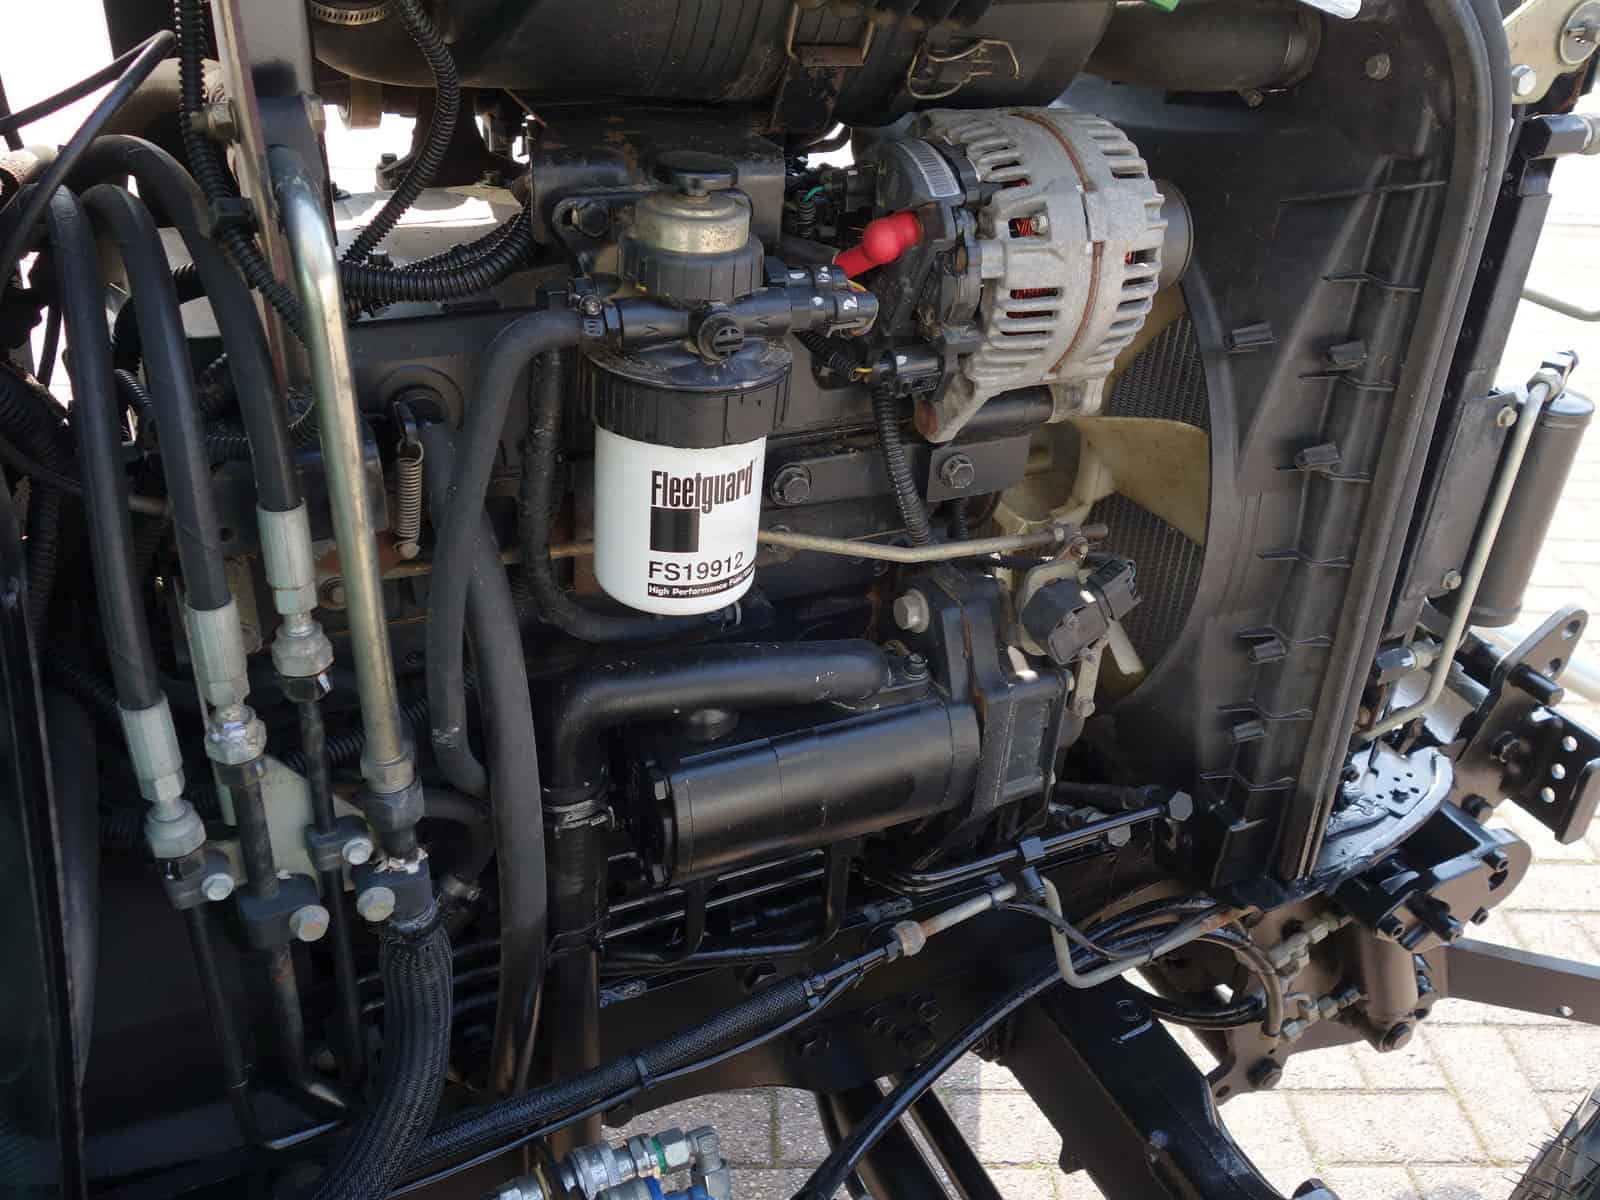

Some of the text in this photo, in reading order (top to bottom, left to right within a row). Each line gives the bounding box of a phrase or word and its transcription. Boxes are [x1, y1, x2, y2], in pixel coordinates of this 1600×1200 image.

[651, 459, 754, 514] Fleetguard
[648, 551, 744, 581] FS19912
[648, 585, 670, 596] High
[672, 581, 728, 596] Performance
